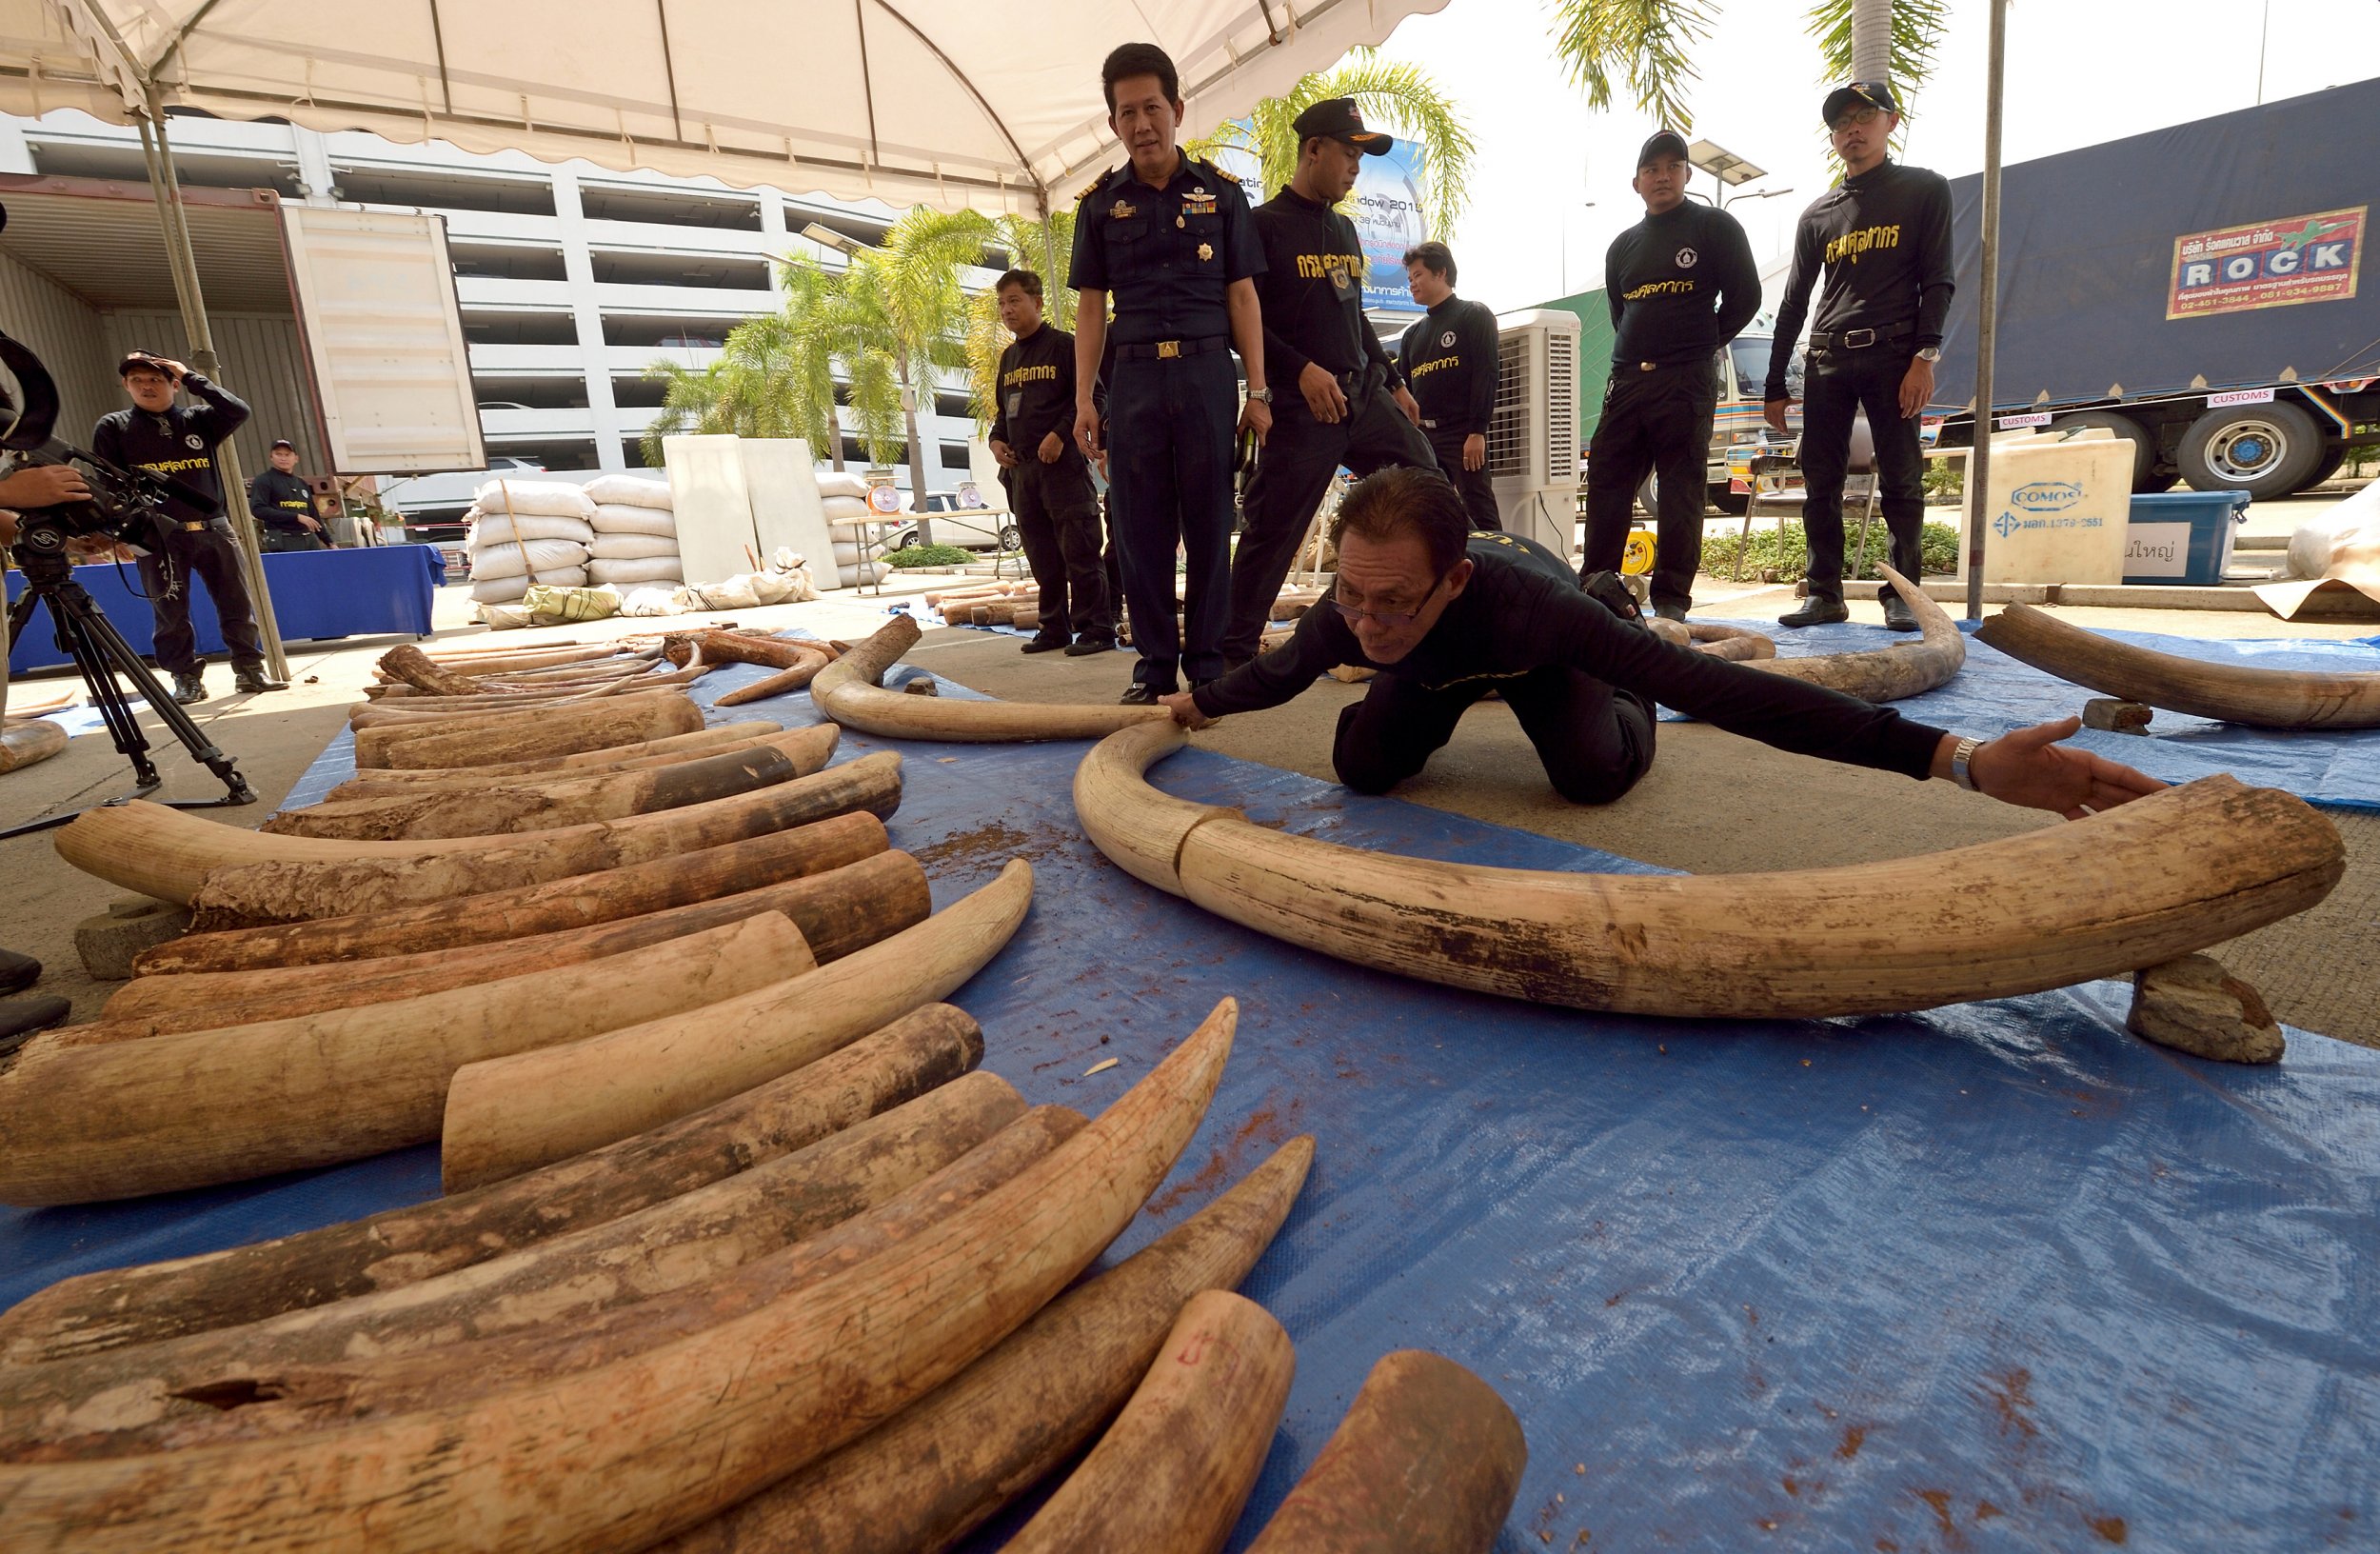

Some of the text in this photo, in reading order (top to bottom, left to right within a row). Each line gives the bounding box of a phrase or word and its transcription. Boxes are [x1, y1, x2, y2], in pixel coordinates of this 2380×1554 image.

[1826, 224, 1900, 265] กรมศุลกากร
[2182, 237, 2204, 255] บริษัท
[2253, 229, 2274, 246] จำกัด
[2187, 244, 2345, 286] ROCK
[1004, 365, 1056, 388] กรมศุลกากร
[2213, 389, 2270, 404] CUSTOMS
[2002, 413, 2046, 426] CUSTOMS
